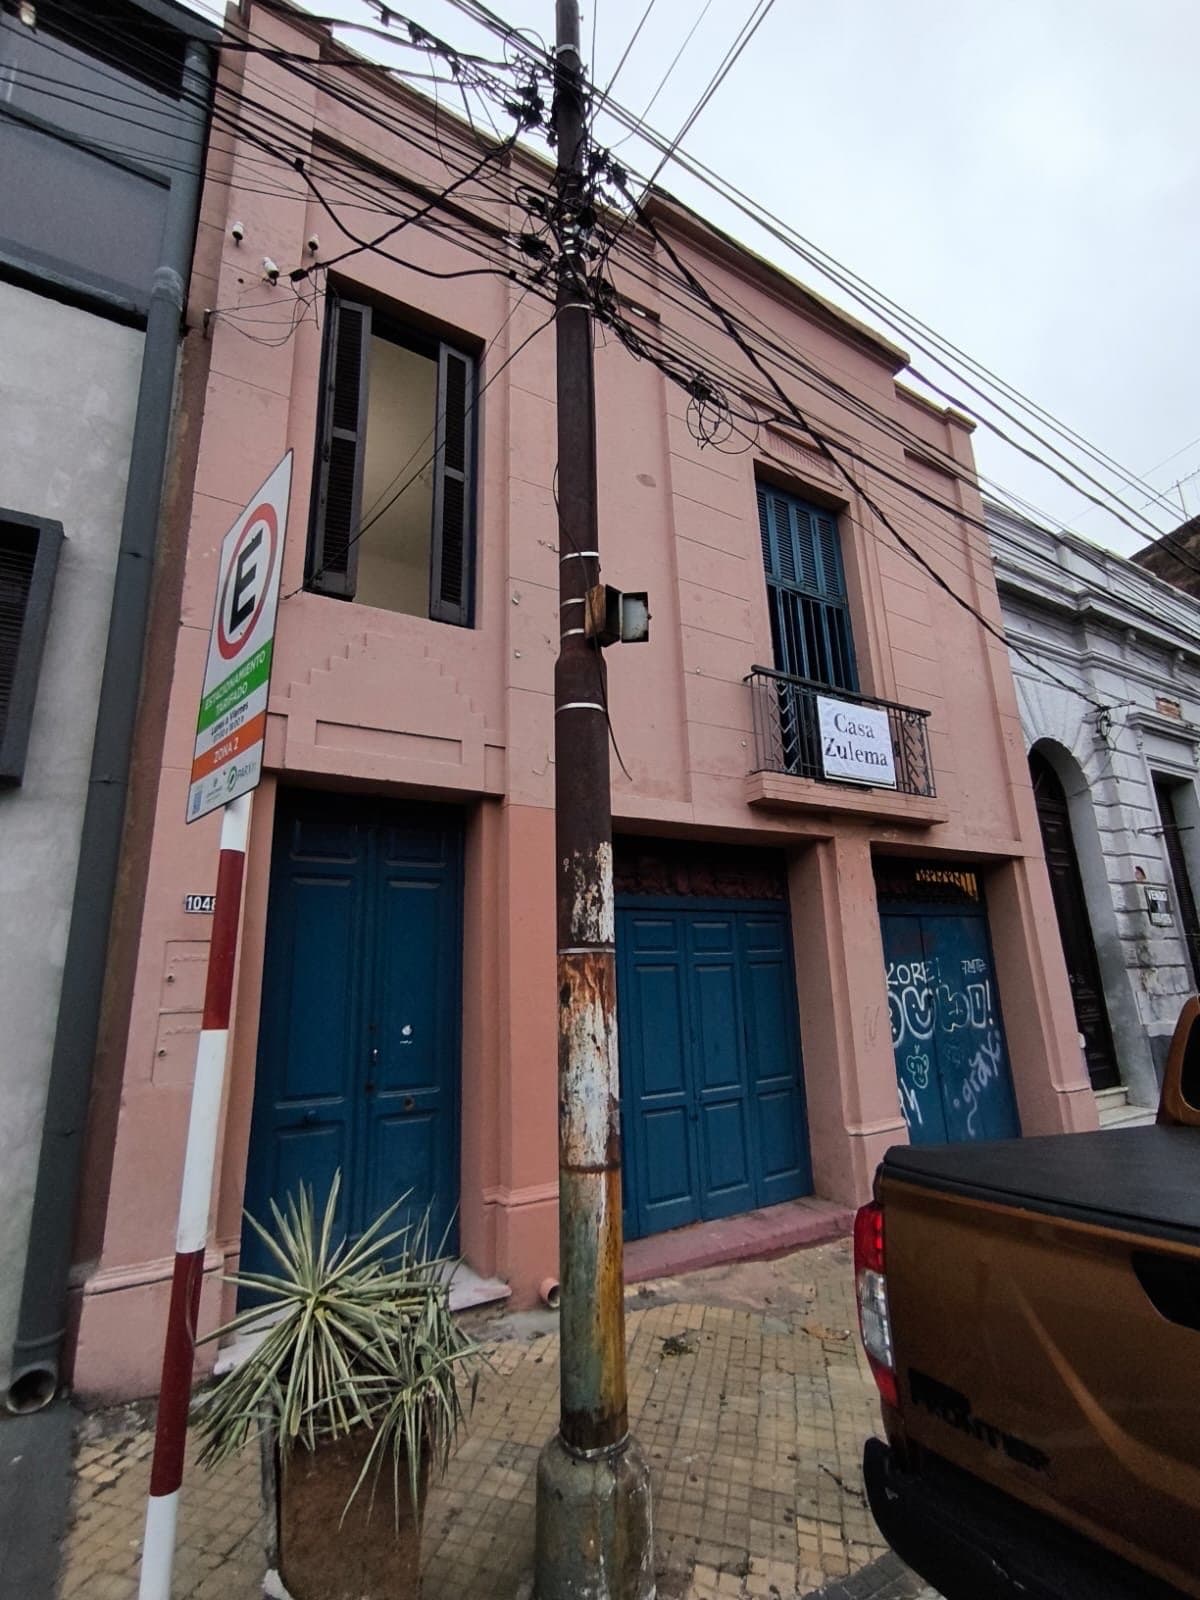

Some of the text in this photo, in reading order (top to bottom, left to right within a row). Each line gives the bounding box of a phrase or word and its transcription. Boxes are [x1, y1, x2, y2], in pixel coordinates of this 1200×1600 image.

[228, 527, 263, 635] E
[834, 712, 875, 739] Casa
[213, 741, 233, 764] ZONA
[823, 736, 888, 767] Zulema
